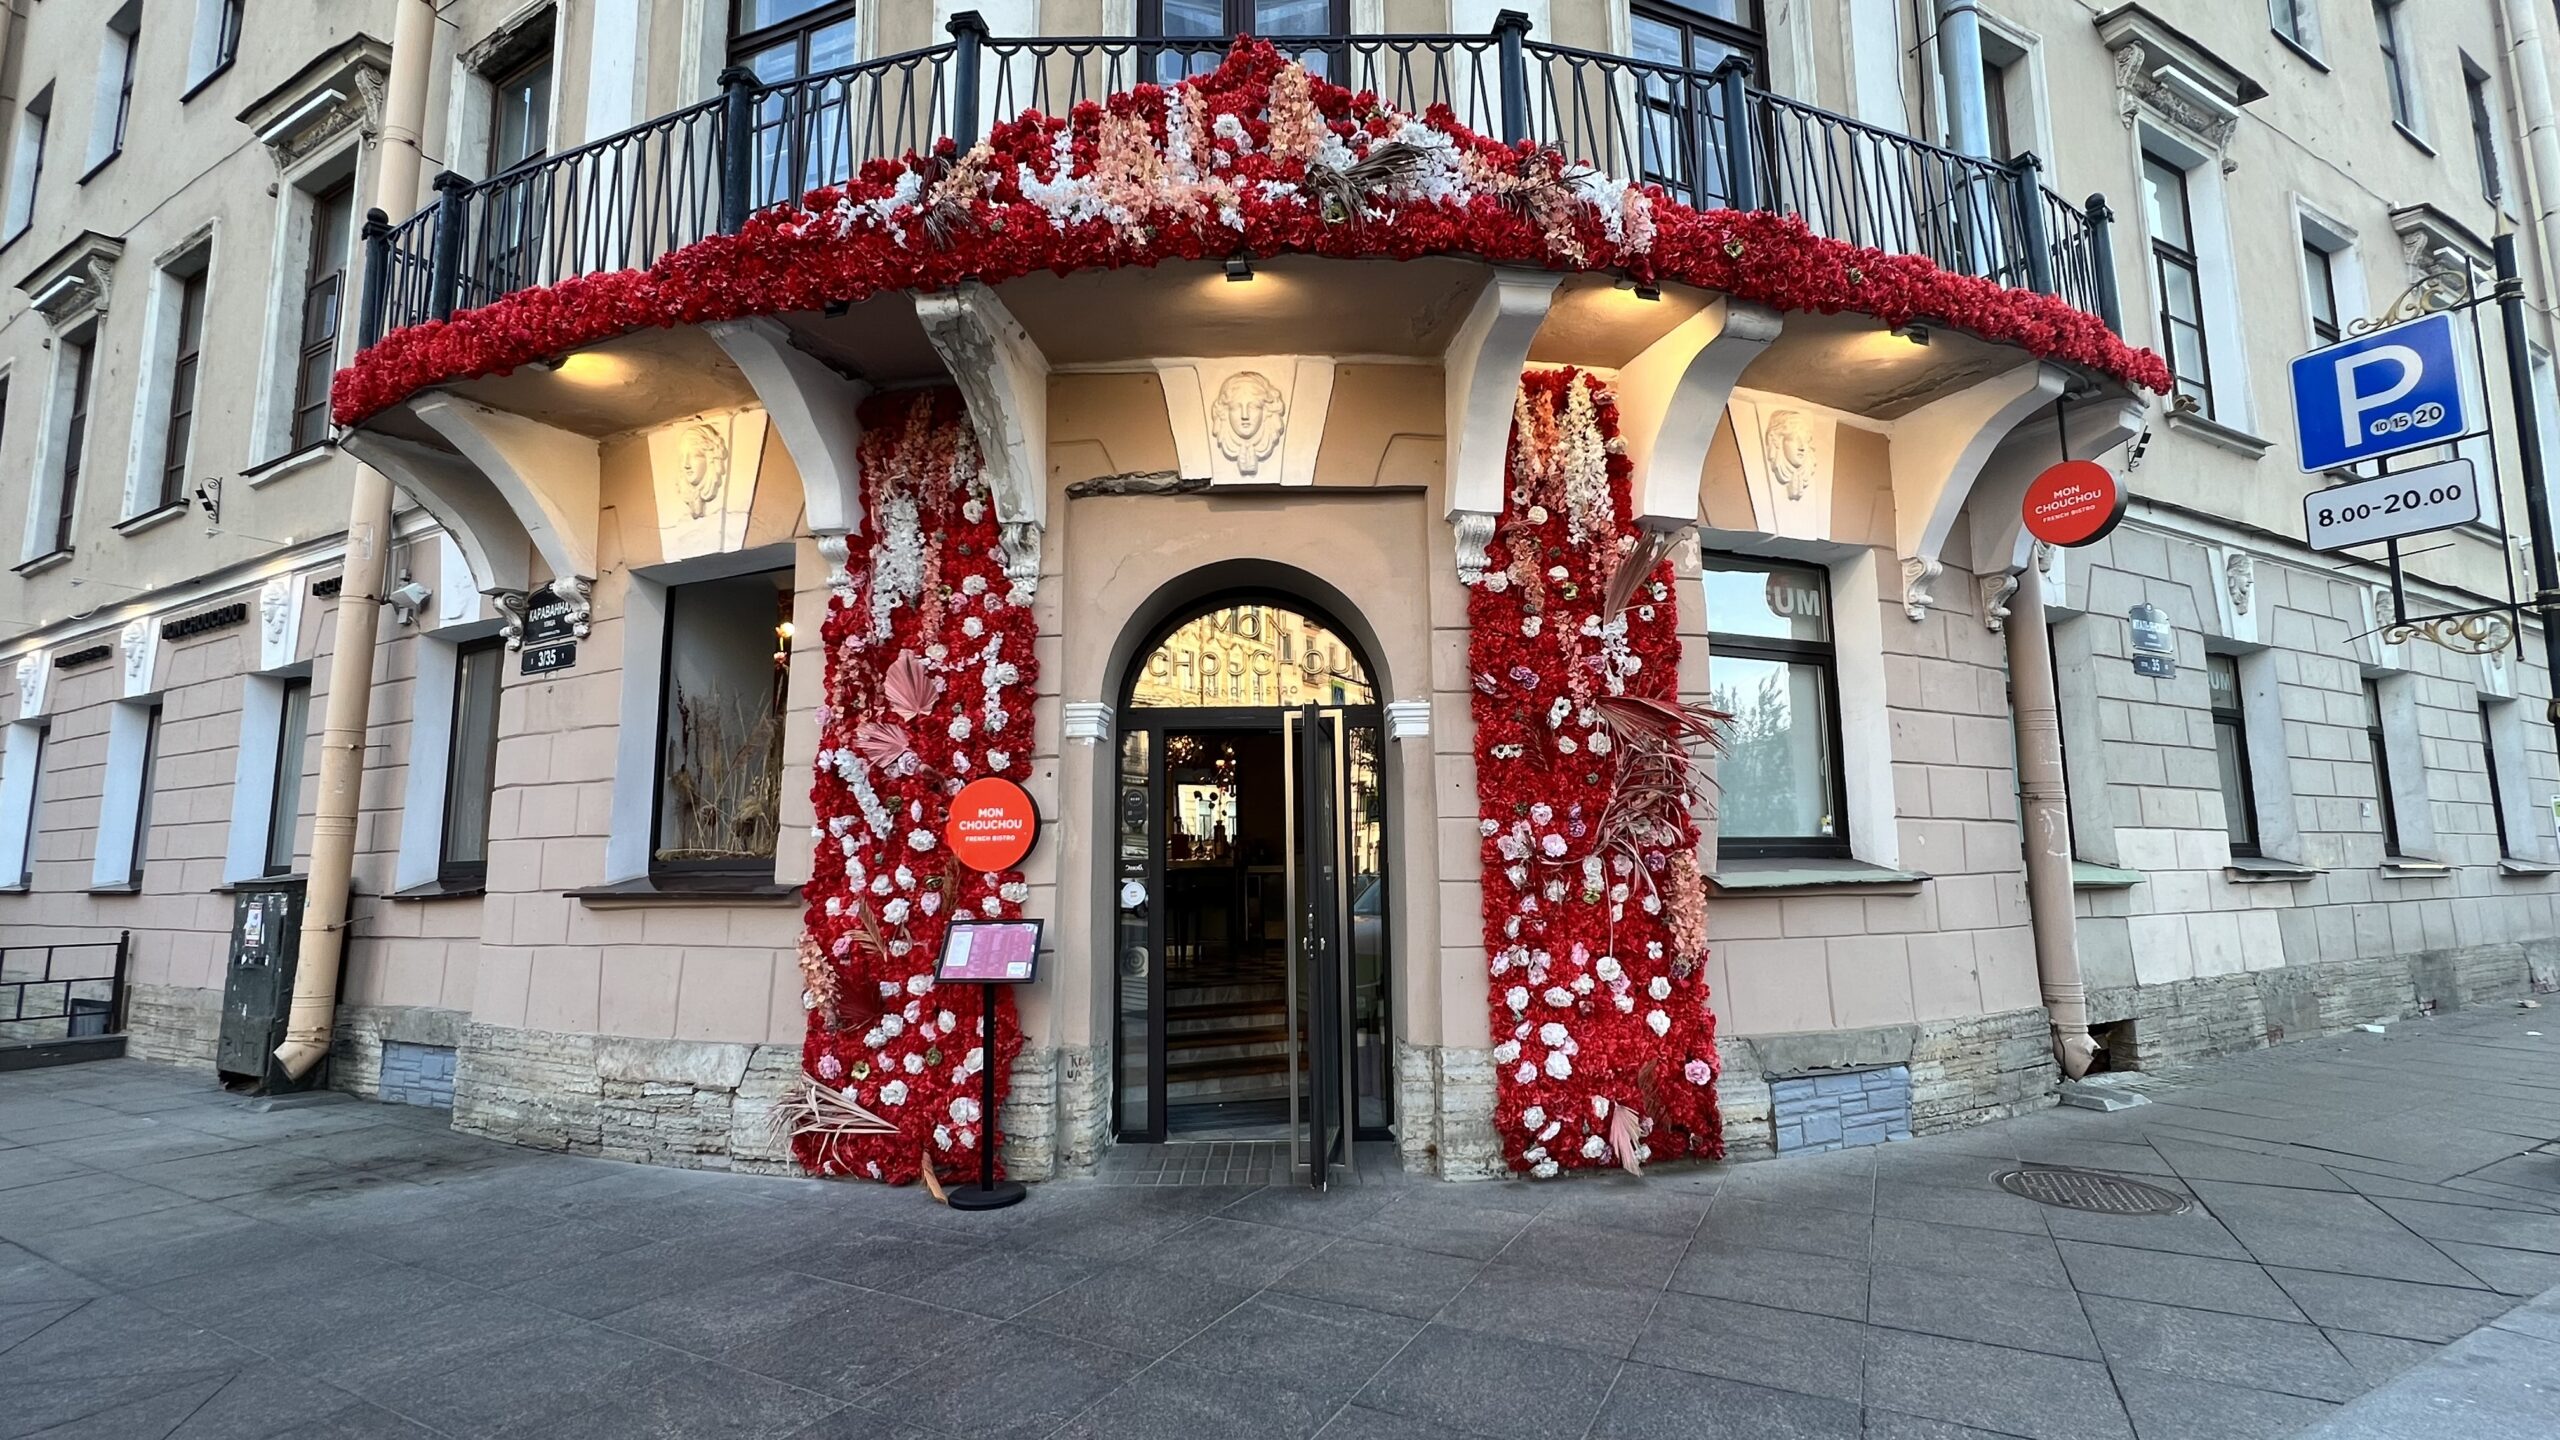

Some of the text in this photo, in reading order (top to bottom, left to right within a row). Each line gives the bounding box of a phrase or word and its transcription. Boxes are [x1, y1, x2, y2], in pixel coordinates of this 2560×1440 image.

[2334, 344, 2423, 448] P
[2375, 405, 2442, 432] 10 15 20
[2035, 489, 2102, 515] CHOUCHOU
[2053, 485, 2080, 499] MON
[2043, 504, 2096, 523] FRENCH BISTRO
[2318, 484, 2462, 527] 8.00-20.00
[1210, 613, 1287, 638] MON
[538, 649, 557, 667] 3/35
[1147, 649, 1352, 677] CHOUCHOU
[977, 807, 1004, 818] MON
[959, 819, 1023, 831] CHOUCHOU
[992, 834, 1016, 842] BISTRO
